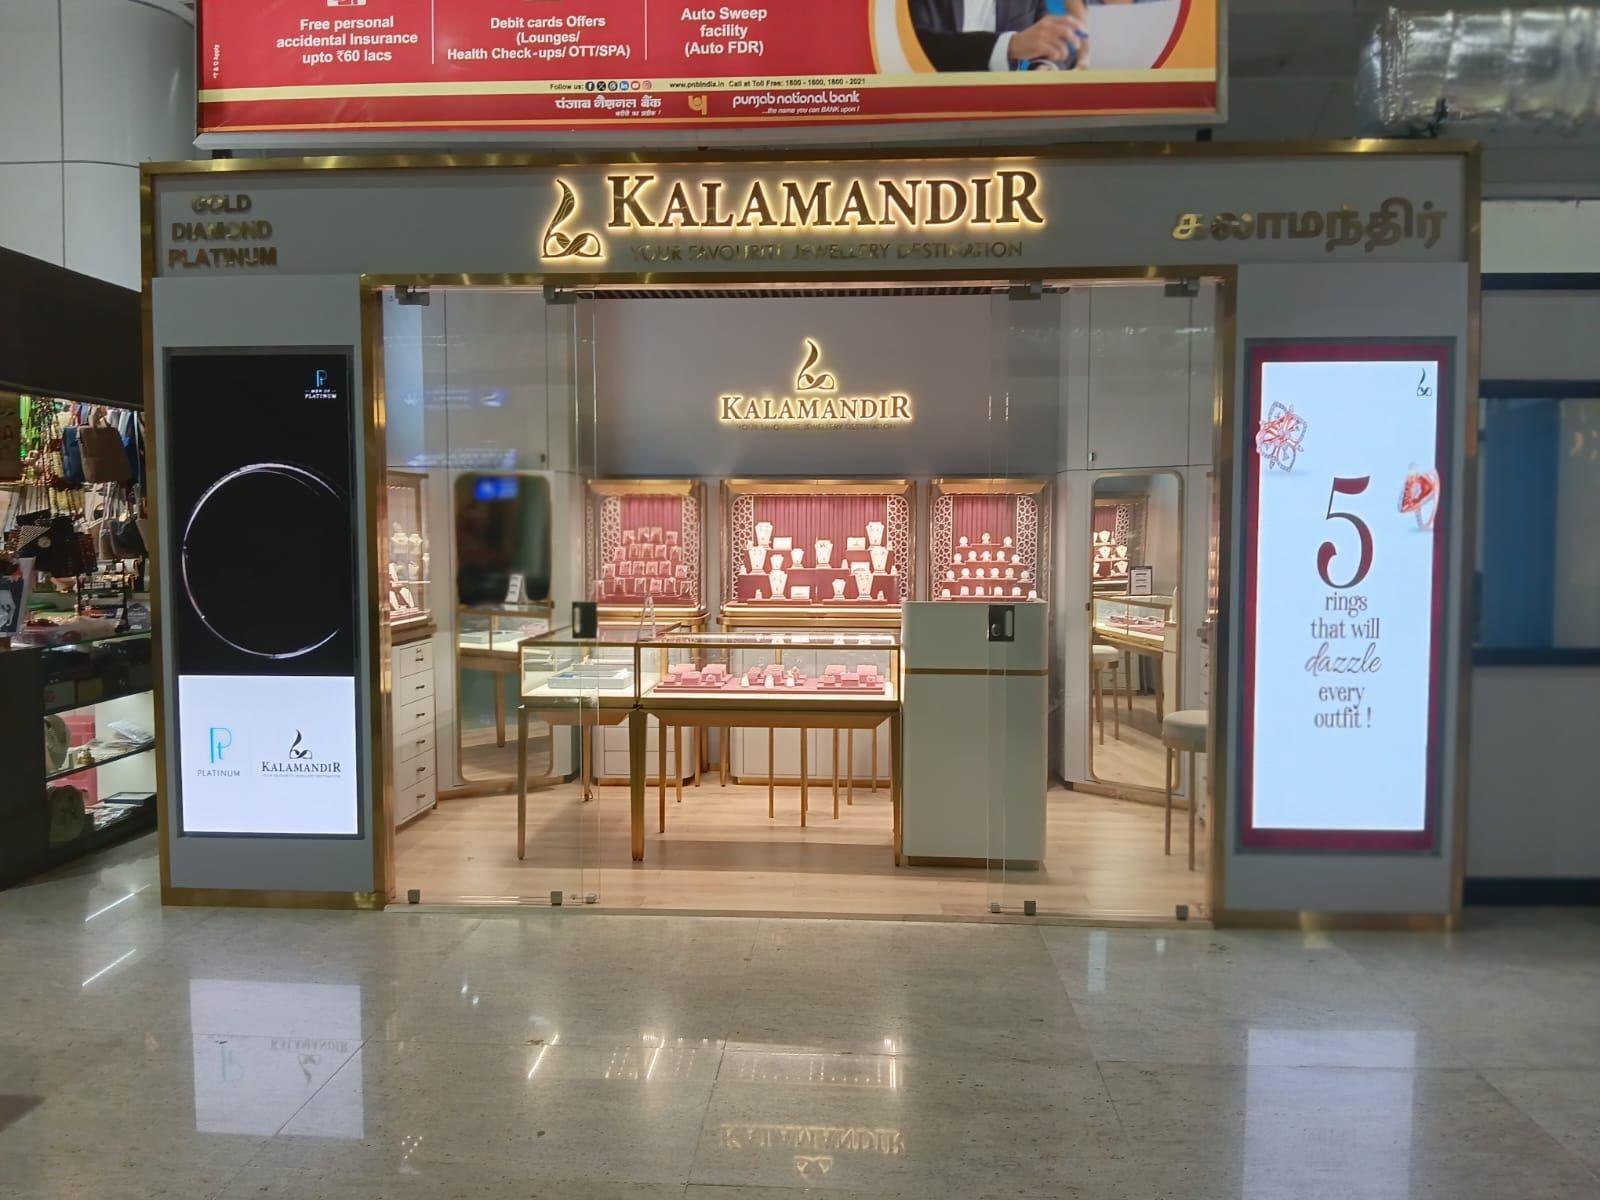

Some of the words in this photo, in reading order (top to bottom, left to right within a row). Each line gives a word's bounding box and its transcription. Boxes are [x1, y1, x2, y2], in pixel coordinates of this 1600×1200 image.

[300, 18, 330, 30] Free
[334, 16, 394, 32] personal
[490, 17, 524, 29] Debit
[527, 16, 562, 28] cards
[566, 16, 606, 27] Offers
[681, 8, 715, 20] Auto
[719, 7, 767, 21] Sweep
[276, 34, 346, 48] accidental
[516, 31, 580, 46] (Lounges/
[700, 24, 748, 39] facility
[302, 52, 333, 66] upto
[336, 50, 360, 62] ₹60
[364, 50, 392, 61] lacs
[448, 48, 487, 60] Health
[569, 45, 630, 59] OTT/SPA)
[684, 42, 724, 57] (Auto
[728, 40, 764, 56] FDR)
[555, 97, 592, 109] पंजाब
[640, 94, 661, 108] बैंक
[733, 92, 775, 108] punjab
[777, 91, 827, 104] national
[829, 91, 859, 103] bank
[192, 194, 252, 214] GOLD
[607, 169, 1046, 228] KALAMANDIR
[172, 220, 272, 241] DIAMOND
[1172, 197, 1447, 252] கலாமந்திர்
[169, 246, 278, 268] PLATINUM
[632, 245, 681, 262] YOUR
[792, 242, 889, 260] JEWELLERY
[898, 241, 1023, 259] DESTINATION
[720, 396, 910, 420] KALAMANDIR
[1317, 476, 1373, 589] 5
[1325, 592, 1368, 617] rings
[1311, 617, 1346, 639] that
[1351, 618, 1380, 639] will
[1304, 642, 1382, 677] dazzle
[1318, 686, 1365, 709] every
[1314, 707, 1362, 728] outfit
[262, 761, 341, 772] KALAMANDIR
